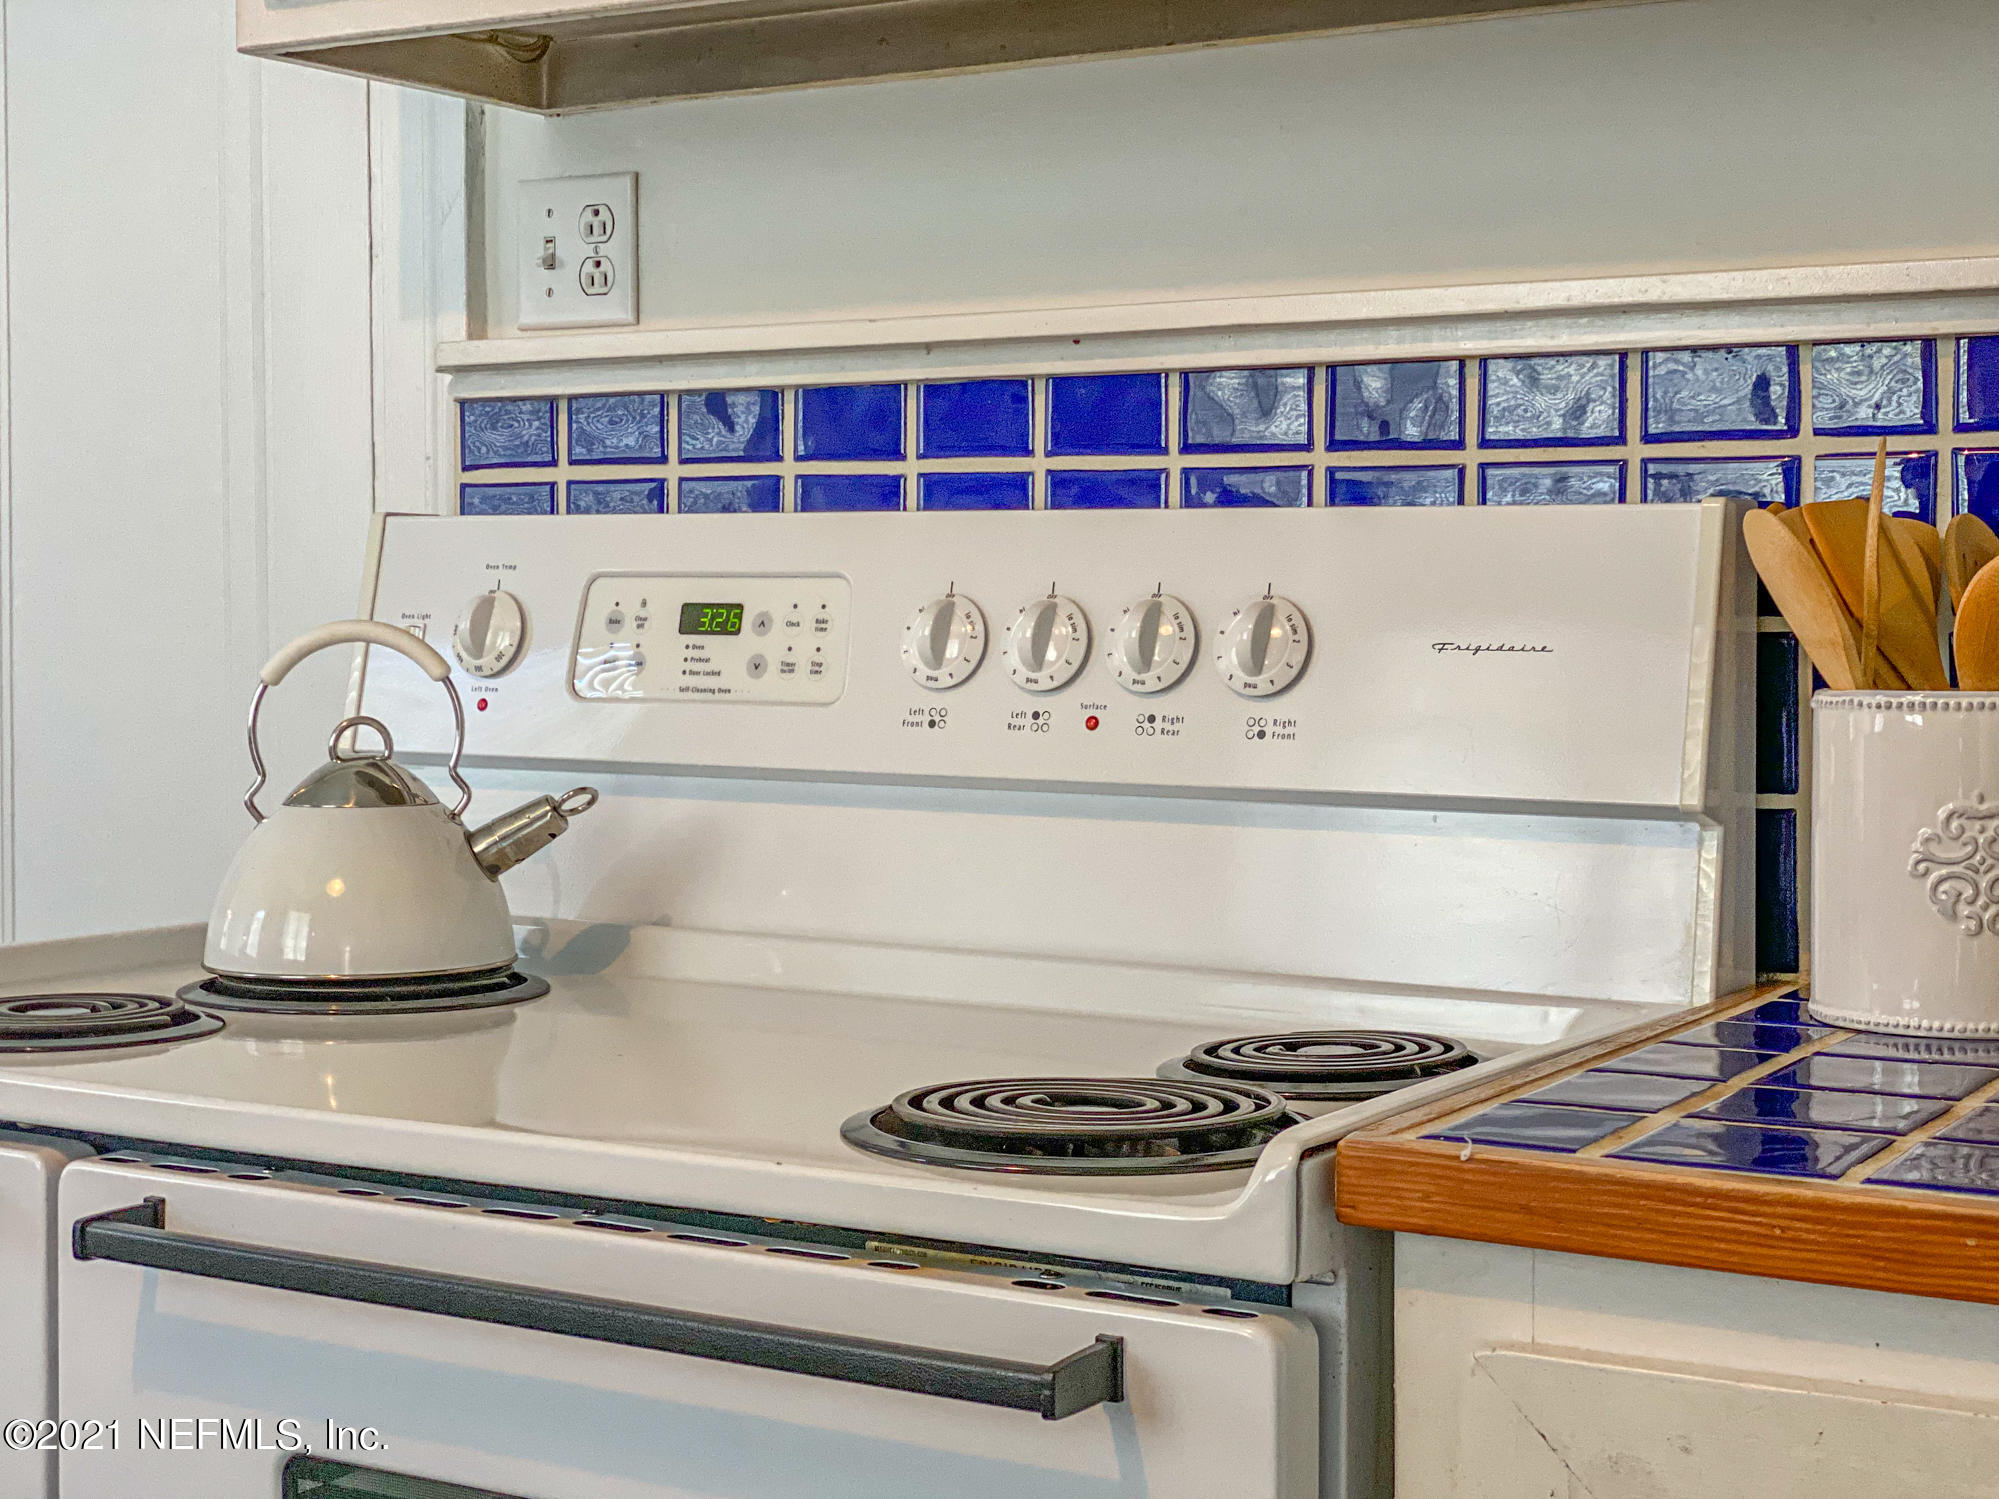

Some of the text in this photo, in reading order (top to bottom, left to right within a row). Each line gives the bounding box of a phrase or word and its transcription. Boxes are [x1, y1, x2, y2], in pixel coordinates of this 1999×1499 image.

[502, 563, 517, 571] Temp
[417, 613, 432, 621] Light
[697, 607, 742, 631] 3:26
[785, 620, 800, 628] Clock
[1176, 621, 1185, 633] sim
[1289, 622, 1299, 636] sim
[1431, 642, 1554, 656] Frigidaire
[690, 656, 711, 664] Preheat
[810, 660, 823, 668] Stop
[688, 669, 721, 677] Door Locked
[1080, 702, 1108, 710] Surface
[909, 707, 925, 716] Left
[1010, 710, 1027, 719] Left
[902, 719, 924, 728] Front
[1161, 714, 1185, 726] Right
[1272, 718, 1297, 730] Right
[1007, 722, 1026, 731] Rear
[1160, 727, 1180, 736] Rear
[1271, 731, 1296, 741] Front
